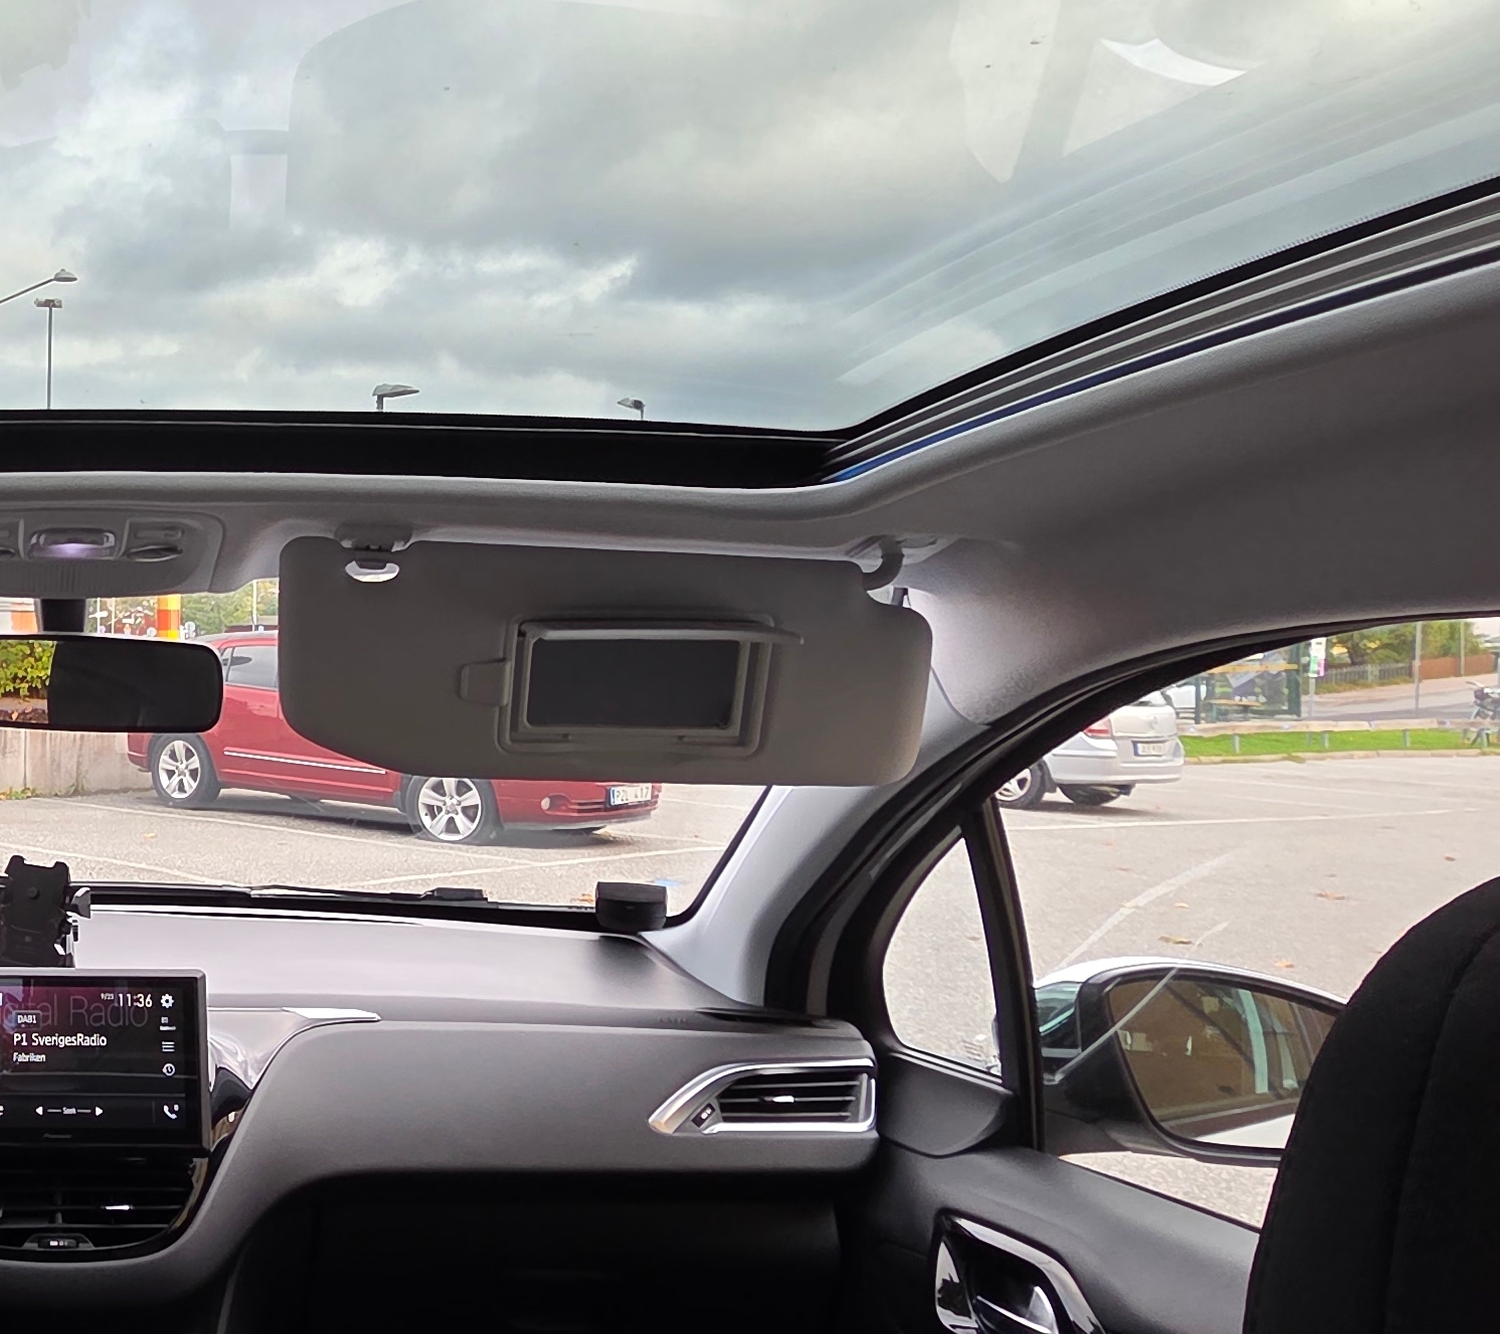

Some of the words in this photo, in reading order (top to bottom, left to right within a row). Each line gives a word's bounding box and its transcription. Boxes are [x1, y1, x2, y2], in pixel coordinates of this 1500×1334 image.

[118, 993, 153, 1007] 11:36
[70, 993, 149, 1028] Radio
[17, 1014, 37, 1024] DAB1
[13, 1033, 28, 1046] P1
[31, 1033, 107, 1048] SverigesRadio
[13, 1051, 46, 1062] Fabriken
